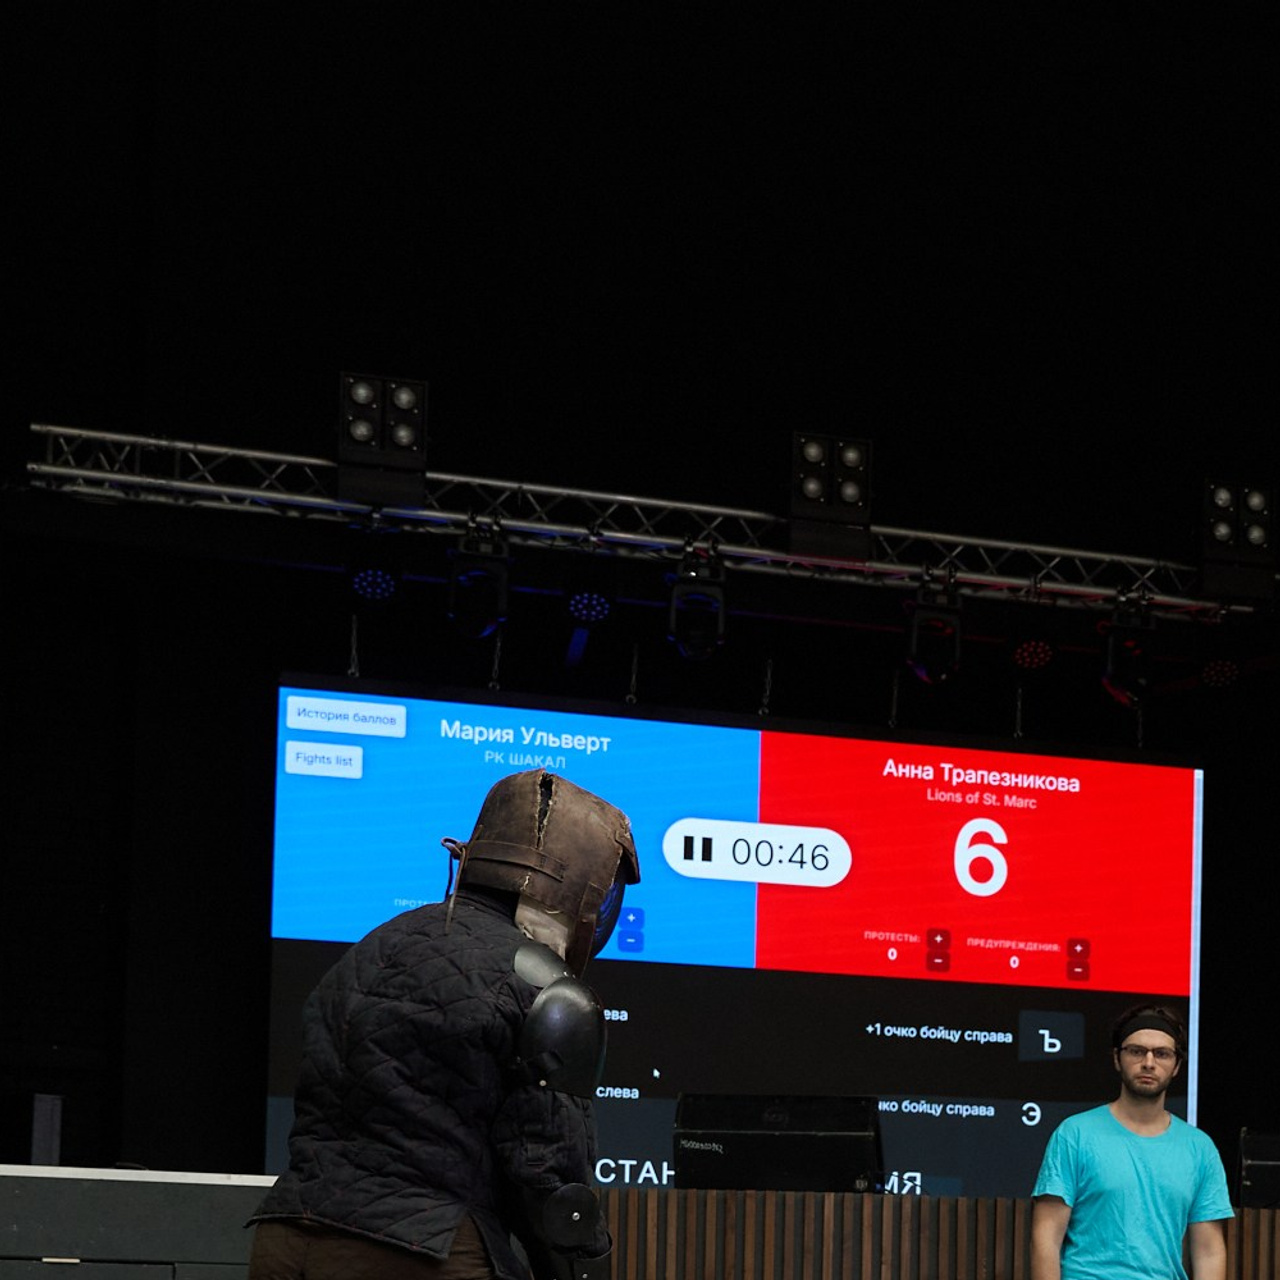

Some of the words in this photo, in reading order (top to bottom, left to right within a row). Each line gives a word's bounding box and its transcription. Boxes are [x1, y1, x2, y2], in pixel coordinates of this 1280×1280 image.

[297, 708, 349, 721] История
[353, 712, 397, 725] баллов
[440, 719, 514, 745] Мария
[520, 726, 612, 755] Ульверт
[295, 752, 332, 766] Fights
[335, 755, 353, 767] list
[484, 751, 505, 764] РК
[509, 753, 566, 769] ШАКАЛ
[883, 758, 935, 780] Анна
[940, 763, 1081, 792] Трапезникова
[926, 788, 963, 804] Lions
[966, 792, 979, 805] of
[983, 793, 1001, 806] St.
[1004, 795, 1037, 809] Marc
[732, 838, 830, 871] 00:46
[954, 817, 1008, 897] 6
[864, 930, 921, 943] ПРОТЕСТЫ:
[887, 948, 898, 961] 0
[1009, 955, 1020, 968] 0
[603, 1009, 628, 1022] ева
[865, 1022, 881, 1036] +1
[884, 1025, 917, 1038] очко
[920, 1025, 962, 1043] бойцу
[964, 1030, 1013, 1045] справа
[1038, 1029, 1062, 1053] Ъ
[595, 1086, 639, 1099] слева
[901, 1100, 943, 1117] бойцу
[946, 1103, 995, 1118] справа
[1021, 1102, 1042, 1126] Э
